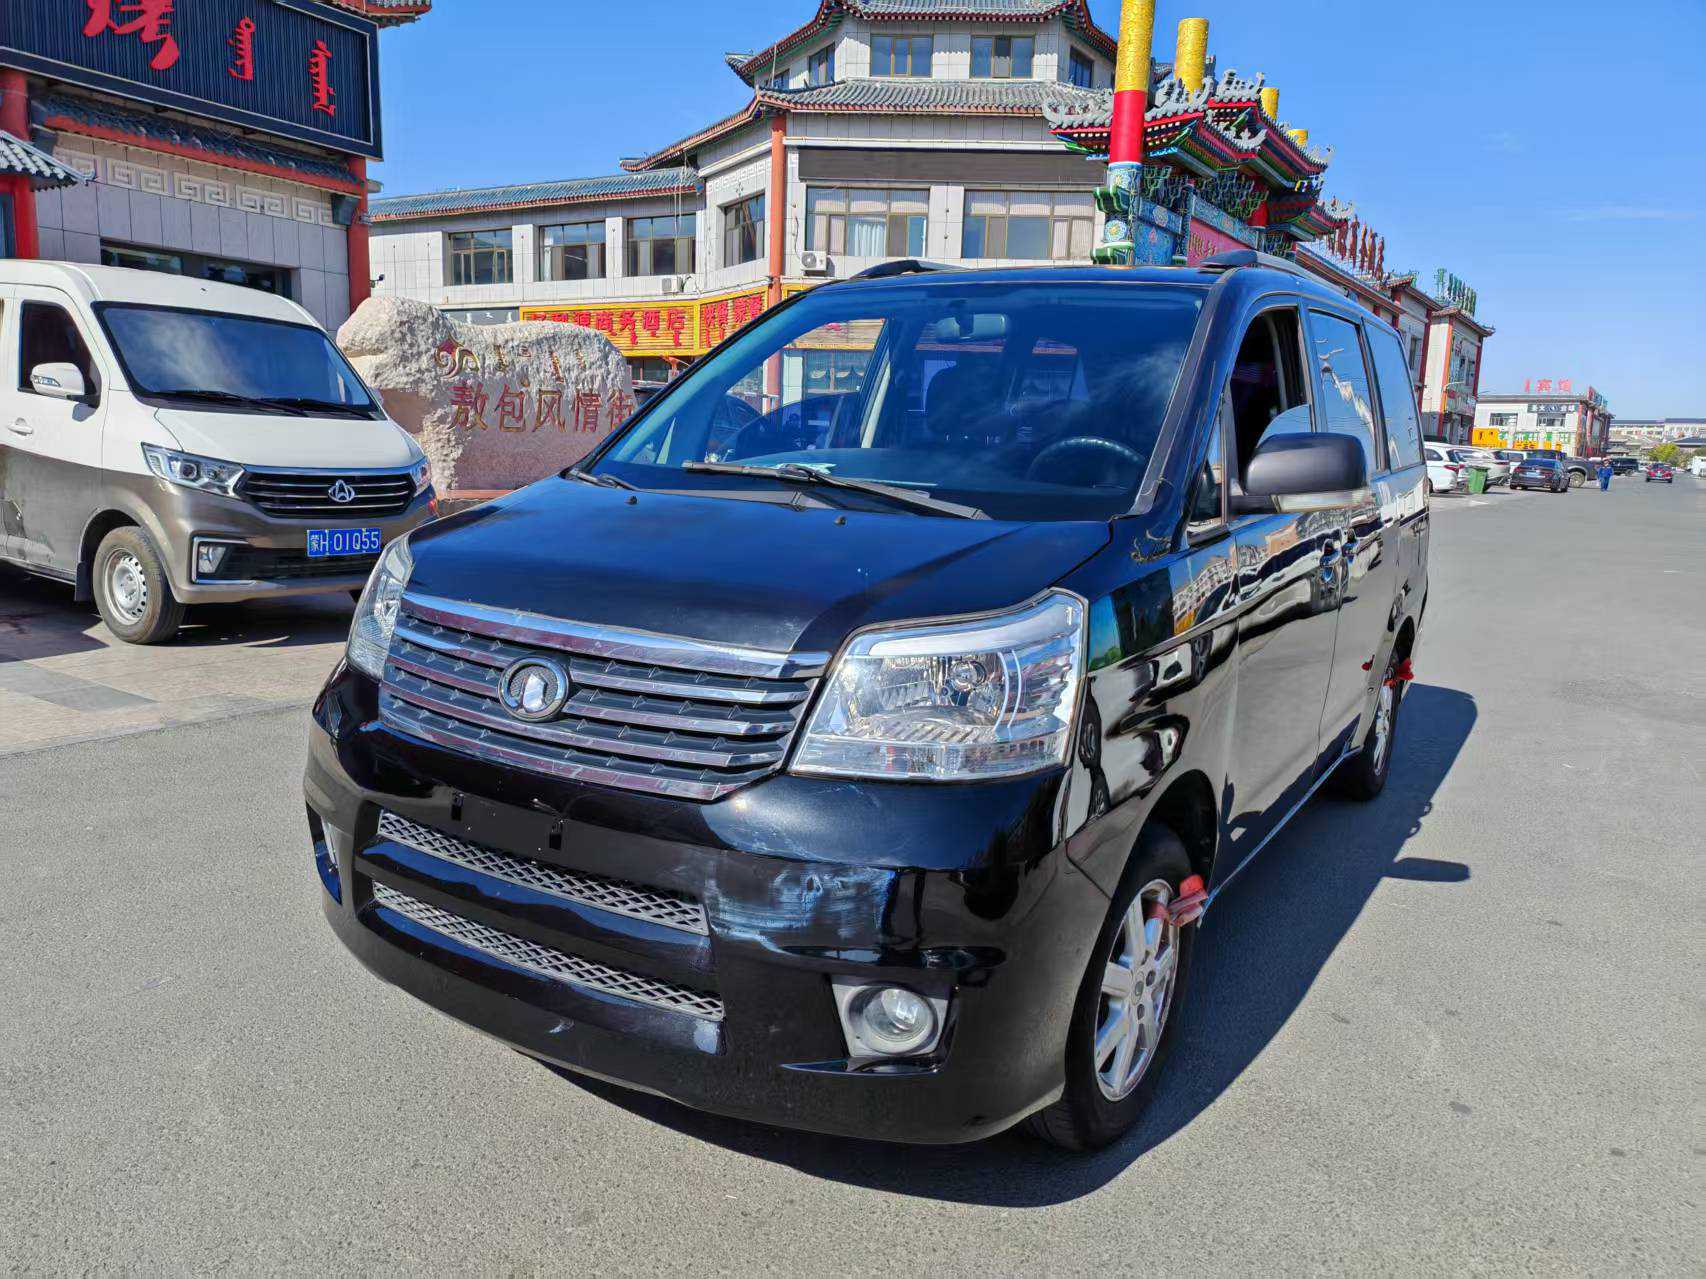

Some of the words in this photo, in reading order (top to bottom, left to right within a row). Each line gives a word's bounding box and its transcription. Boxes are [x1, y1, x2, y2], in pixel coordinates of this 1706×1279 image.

[447, 380, 635, 433] 敖包风情街
